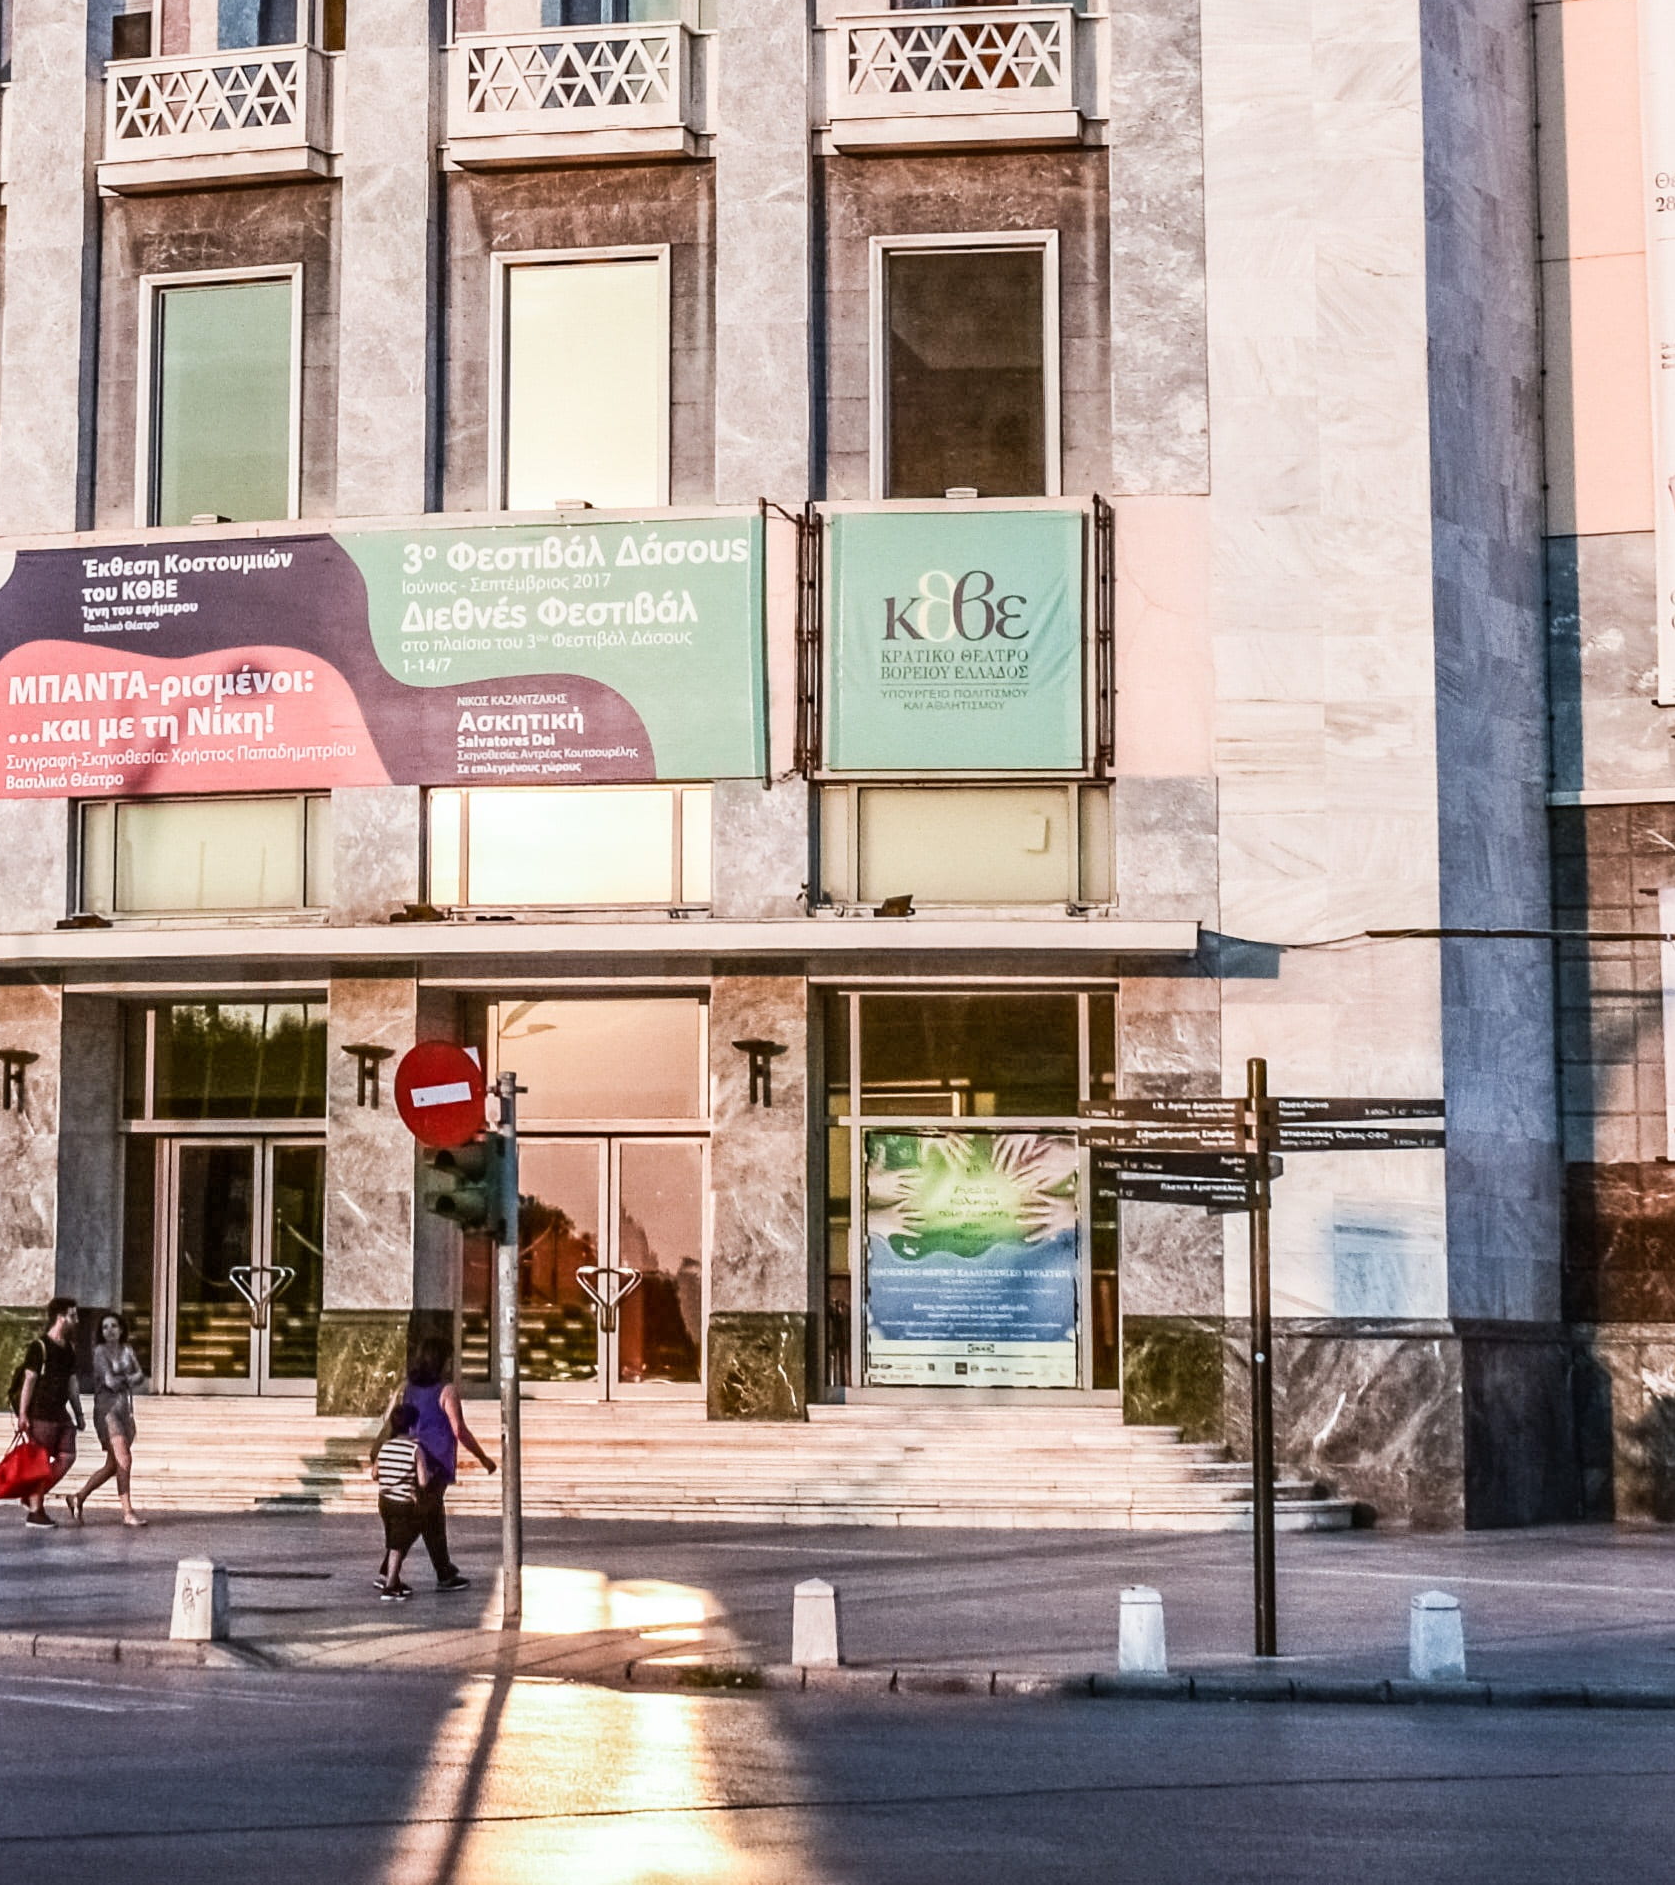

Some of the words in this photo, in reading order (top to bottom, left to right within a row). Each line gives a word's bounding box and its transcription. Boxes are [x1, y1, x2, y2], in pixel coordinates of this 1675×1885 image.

[446, 535, 606, 572] Φεστιβάλ
[615, 532, 750, 566] Δάσους
[82, 556, 160, 581] Έκθεση
[164, 549, 293, 574] Κοστουμιών
[81, 587, 118, 603] του
[122, 579, 179, 601] ΚΘΒΕ
[402, 579, 457, 595] Ιούνιος
[470, 576, 570, 594] Σεπτέμβριος
[573, 572, 612, 589] 2017
[112, 605, 133, 617] του
[401, 597, 527, 633] Διεθνές
[536, 589, 699, 627] Φεστιβάλ
[401, 640, 430, 653] στο
[433, 634, 491, 653] πλαίσιο
[495, 636, 523, 650] του
[552, 629, 626, 649] Φεστιβάλ
[630, 628, 693, 647] Δάσους
[402, 657, 452, 673] 1-14/7
[881, 650, 955, 664] ΚΡΑΤΙΚΟ
[961, 649, 1029, 663] ΘΕΑΤΡΟ
[881, 666, 950, 680] ΒΟΡΕΙΟΥ
[955, 665, 1029, 679] ΕΛΛΑΔΟΣ
[8, 665, 314, 706] ΜΠΑΝΤΑ-ρισμένοι:
[457, 694, 489, 707] ΝΙΚΟΣ
[490, 693, 568, 706] ΚΑΖΑΝΤΖΑΚΗΣ
[8, 718, 92, 744] ...και
[98, 715, 135, 747] με
[141, 712, 179, 743] τη
[186, 704, 275, 741] Νίκη!
[457, 707, 585, 736] Ασκητική
[457, 734, 530, 748] Salvatores
[531, 733, 556, 747] Dei
[5, 749, 168, 772] Συγγραφή-Σκηνοθεσία:
[171, 746, 235, 765] Χρήστος
[237, 742, 357, 761] Παπαδημητρίου
[5, 775, 68, 790] Βασιλικό
[70, 773, 125, 789] Θέατρο
